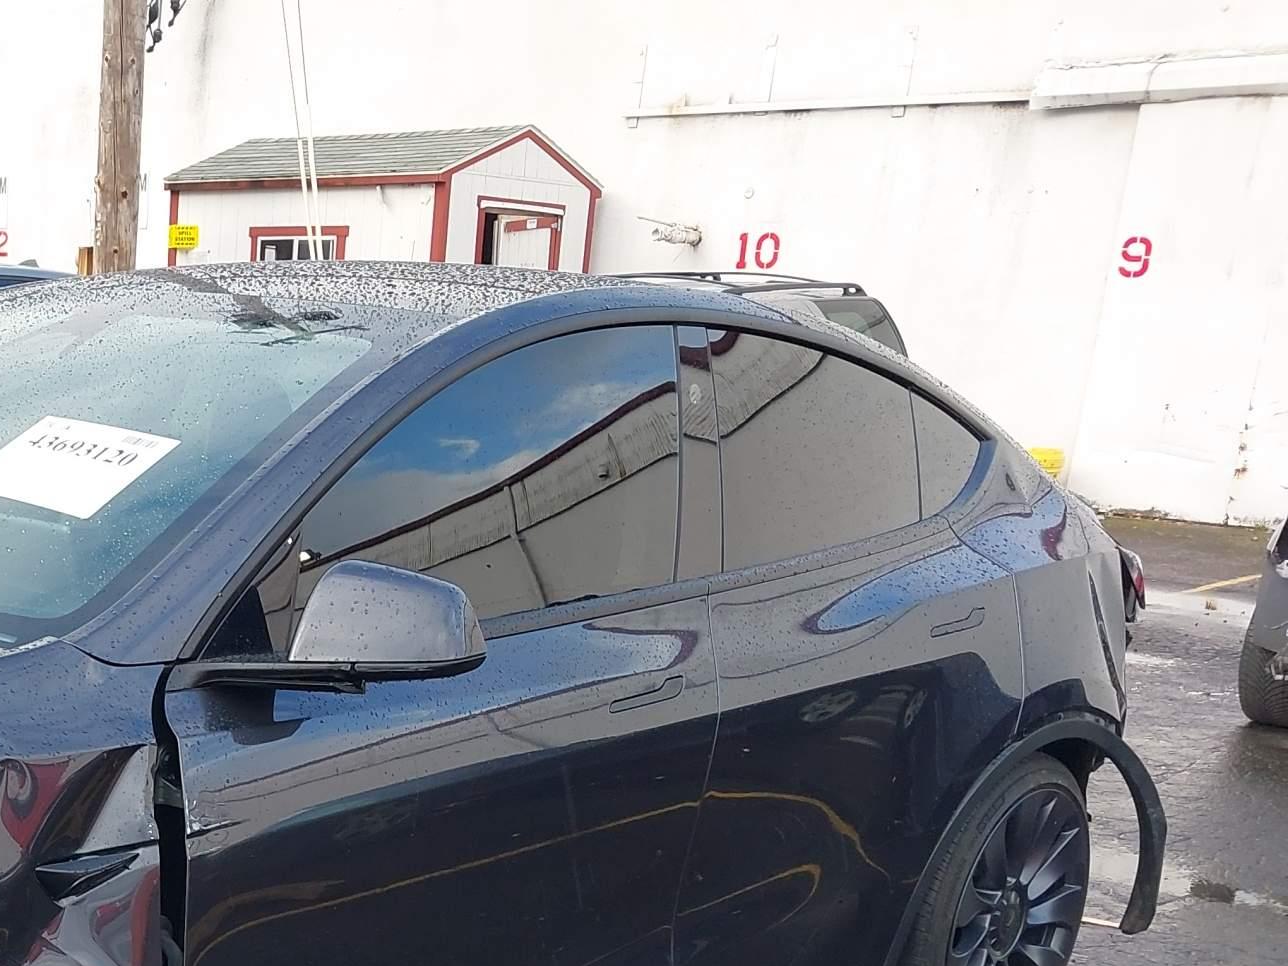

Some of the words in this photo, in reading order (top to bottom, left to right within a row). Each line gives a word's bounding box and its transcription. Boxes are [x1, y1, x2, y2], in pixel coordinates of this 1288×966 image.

[736, 233, 780, 270] 10
[1119, 236, 1152, 278] 9
[28, 434, 139, 467] 43693120
